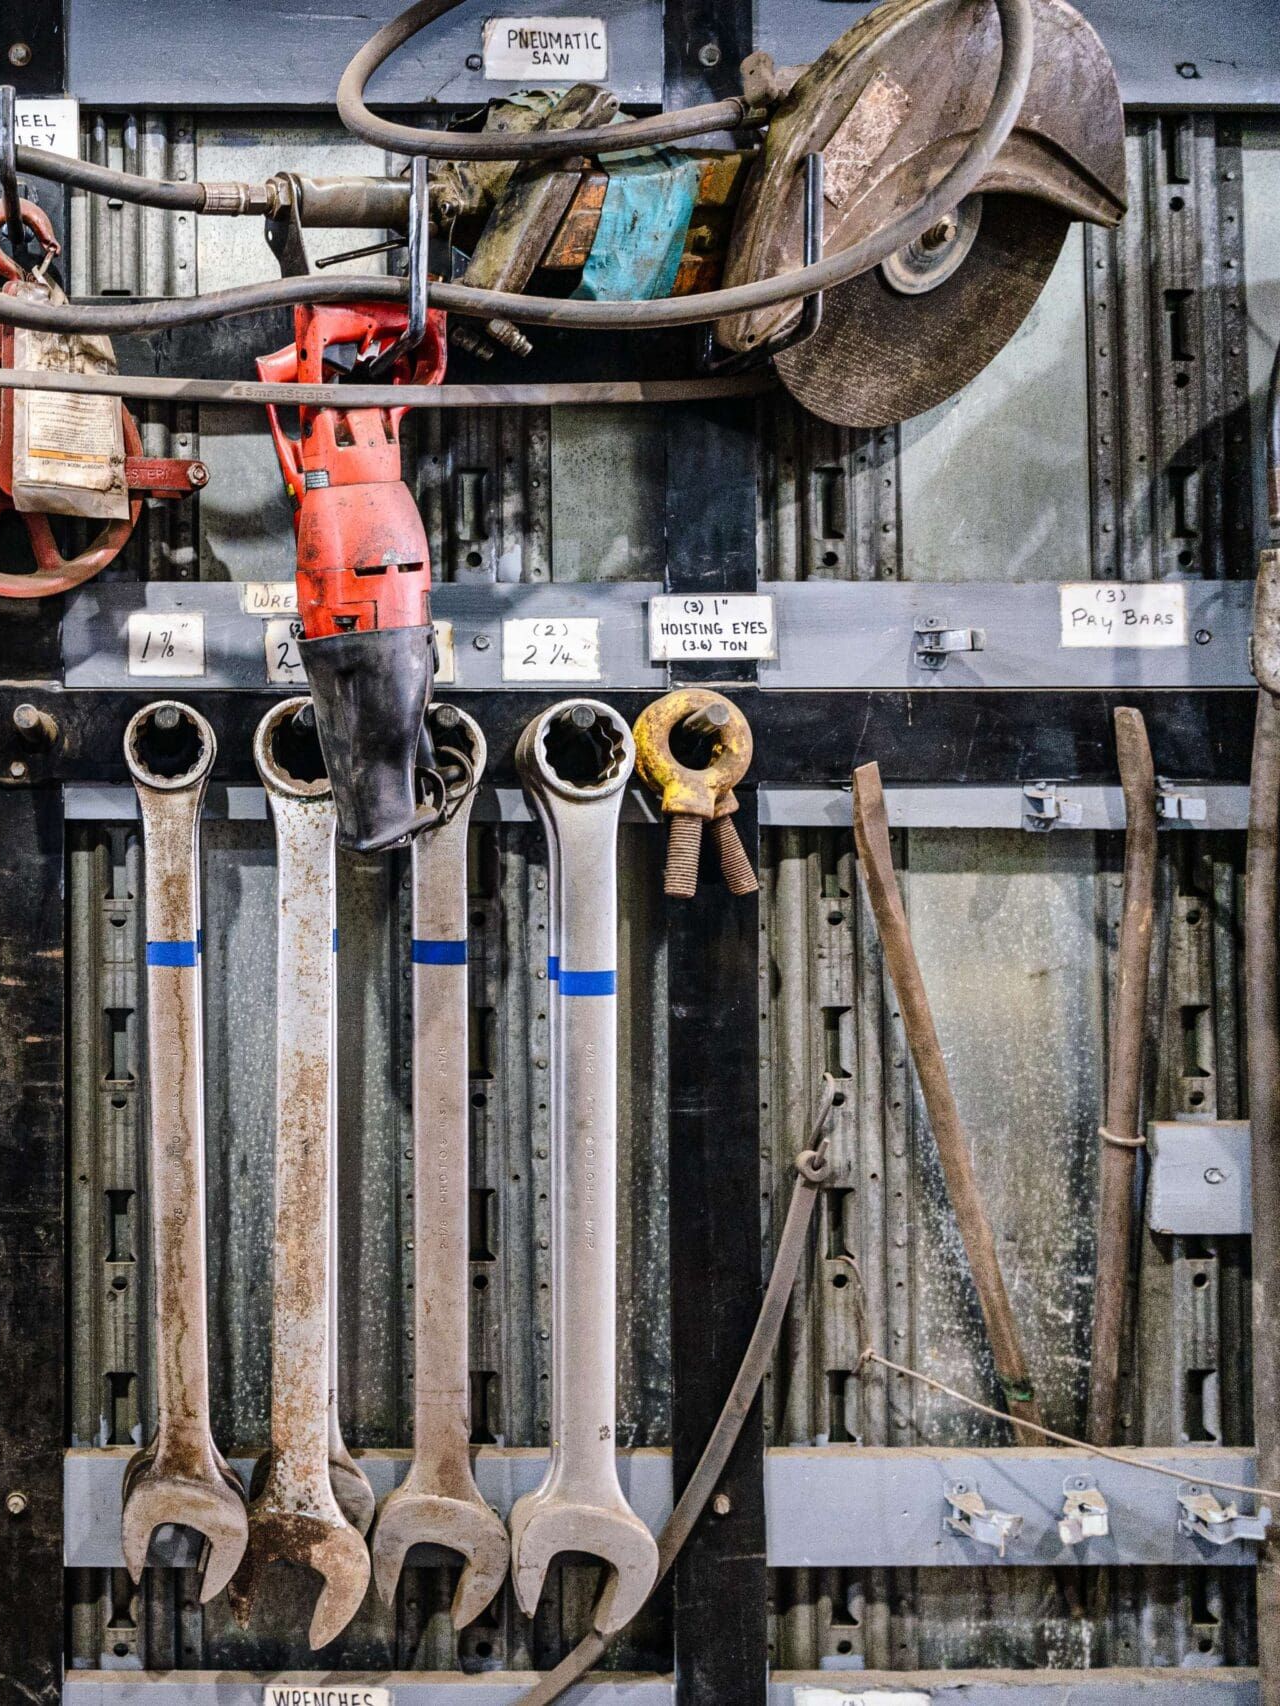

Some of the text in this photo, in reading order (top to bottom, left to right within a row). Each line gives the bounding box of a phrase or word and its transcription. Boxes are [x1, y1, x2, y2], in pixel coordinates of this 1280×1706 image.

[507, 29, 601, 50] PNEUMATIC
[532, 51, 569, 66] SAW
[253, 592, 298, 608] WRE
[1095, 589, 1126, 602] (3)
[683, 599, 704, 615] (3)
[533, 623, 569, 636] (2)
[660, 621, 768, 636] HOISTING EYES
[681, 639, 748, 652] (3.6) TON
[522, 644, 538, 665] 2
